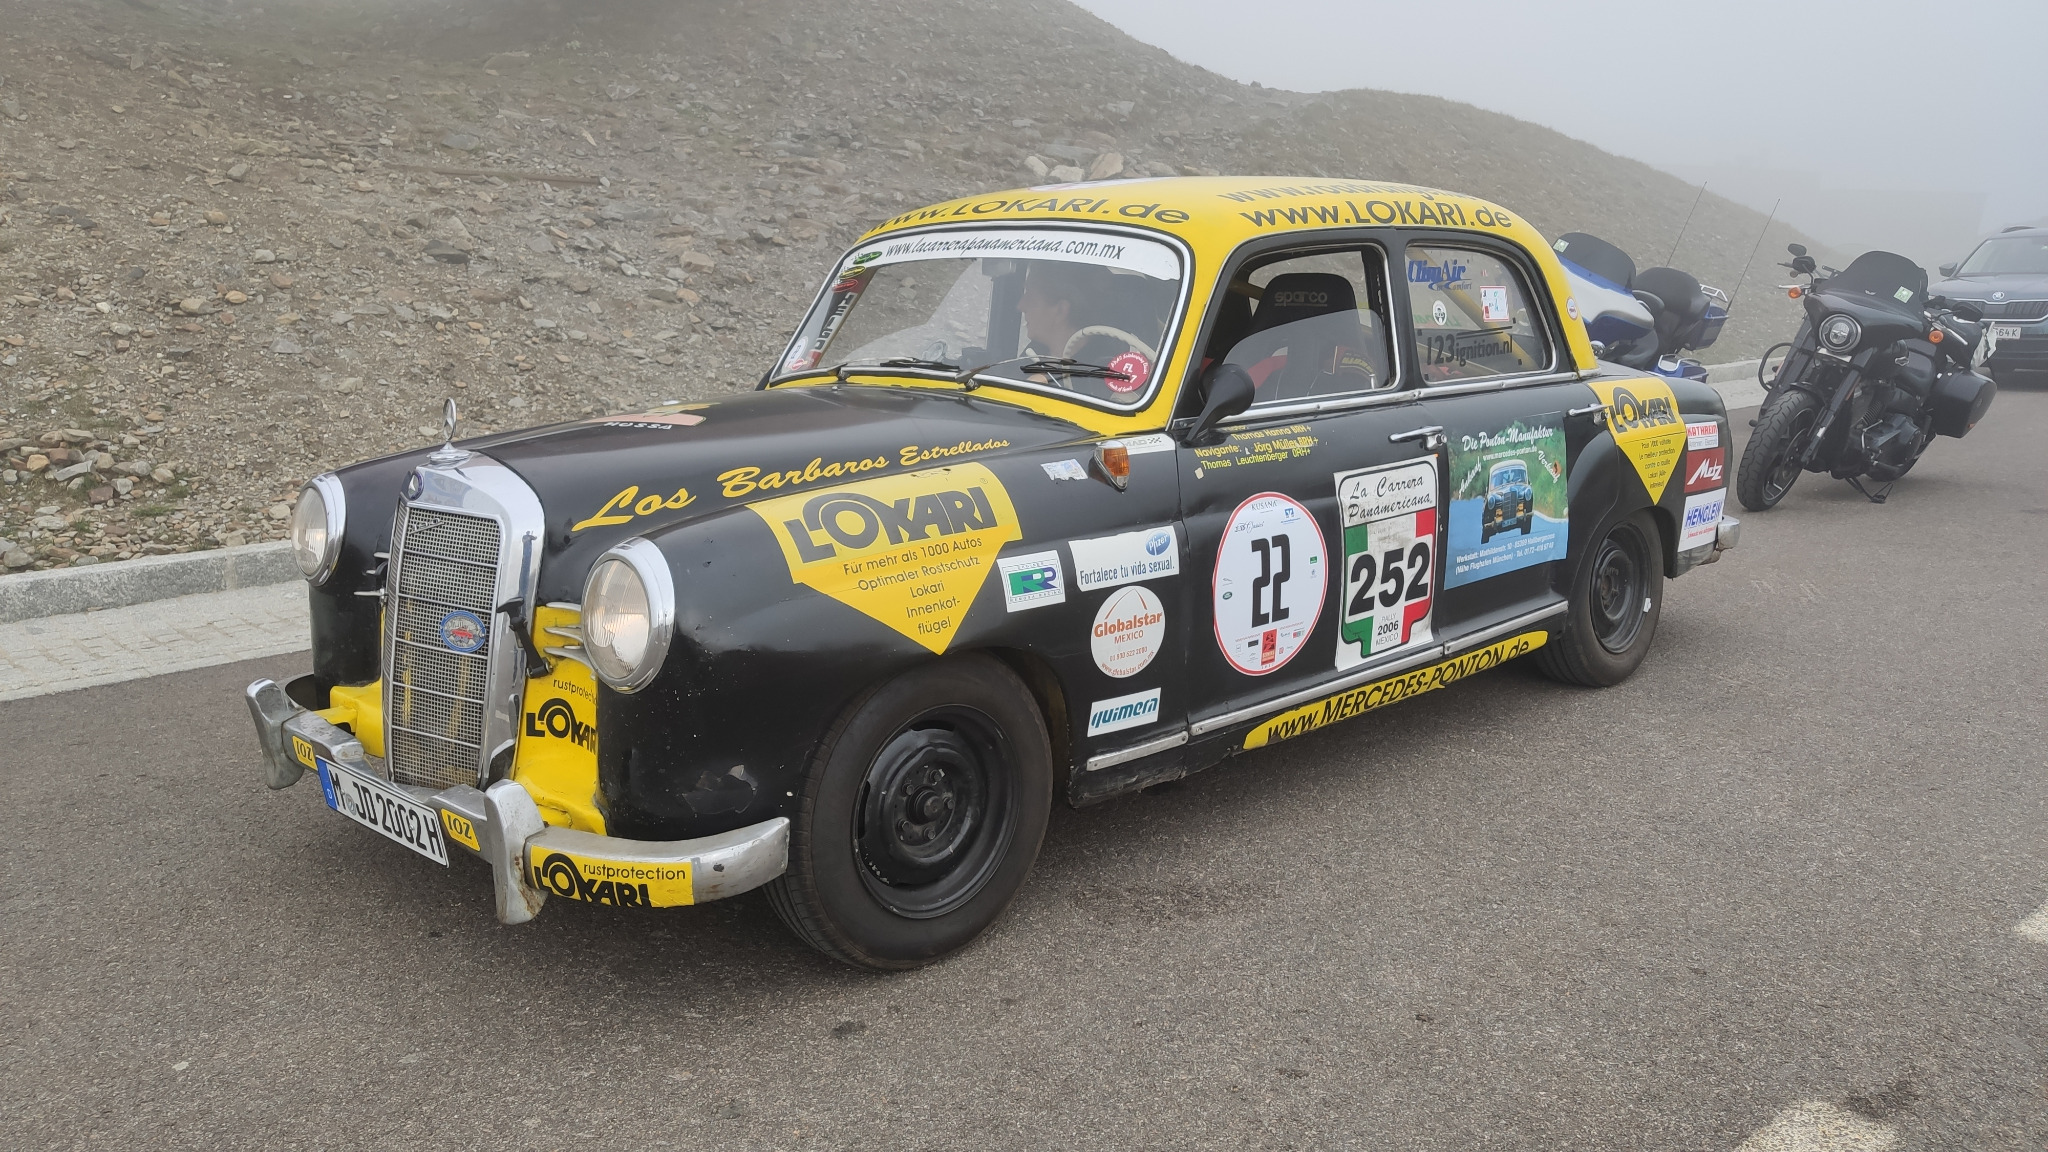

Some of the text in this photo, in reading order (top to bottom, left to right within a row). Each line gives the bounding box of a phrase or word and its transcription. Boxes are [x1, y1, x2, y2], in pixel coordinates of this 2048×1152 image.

[871, 198, 1190, 233] www.LOKARI.de
[1239, 200, 1512, 228] www.LOKARI.de
[886, 236, 1126, 260] www.lacarrerapanamericana.com.mx
[1274, 290, 1329, 308] sparco
[1426, 333, 1513, 367] 123ignition.nl
[1608, 387, 1676, 434] LOKARI
[1231, 431, 1265, 441] Thomas
[1461, 425, 1554, 452] Die Ponton-Manufaktur
[1200, 459, 1232, 470] Thomas
[1235, 451, 1288, 466] Leuchtenberger
[1687, 458, 1722, 486] Metz
[571, 437, 1011, 532] Los Barbaros Estrellados
[1349, 476, 1424, 500] La Carrera
[1347, 493, 1431, 523] Panamericana
[782, 486, 998, 564] LOKARI
[843, 536, 983, 576] Für mehr als 1000 Autos
[857, 556, 981, 592] Optimaler Rostschutz
[1079, 555, 1175, 586] Fortalece tu vida sexual.
[1251, 533, 1291, 629] 22
[1348, 541, 1431, 617] 252
[909, 580, 945, 599] Lokari
[906, 597, 961, 618] Innenkot-
[917, 617, 952, 635] flügel
[1093, 611, 1163, 638] Globalstar
[1114, 629, 1144, 645] MEXICO
[1377, 620, 1399, 636] 2006
[1375, 632, 1399, 646] MEXICO
[1267, 637, 1530, 745] www.MERCEDES-PONTON.de
[329, 769, 347, 811] M
[352, 781, 379, 826] JD
[534, 852, 652, 908] LOKARI
[583, 863, 686, 880] rustprotection
